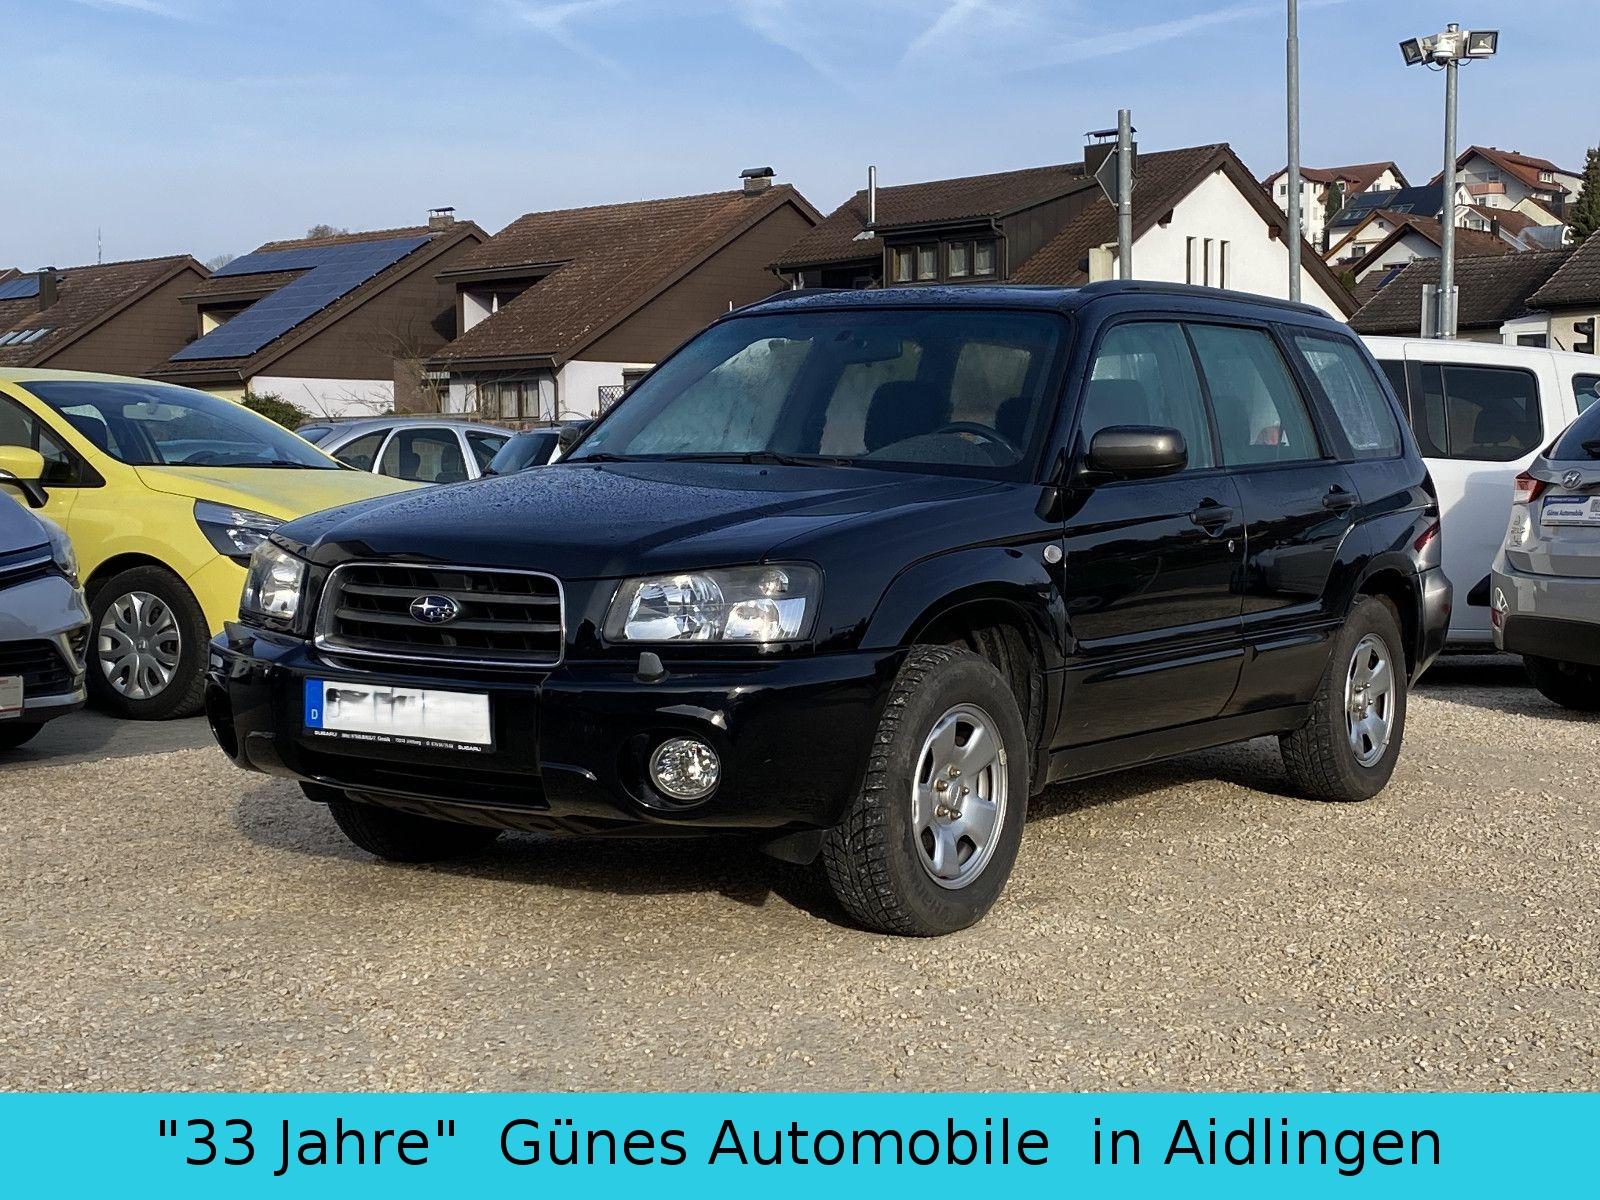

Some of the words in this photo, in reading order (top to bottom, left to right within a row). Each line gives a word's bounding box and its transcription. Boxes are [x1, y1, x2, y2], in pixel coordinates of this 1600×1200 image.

[311, 708, 318, 720] D
[314, 729, 338, 737] SUBARU
[457, 744, 482, 752] SUBARU
